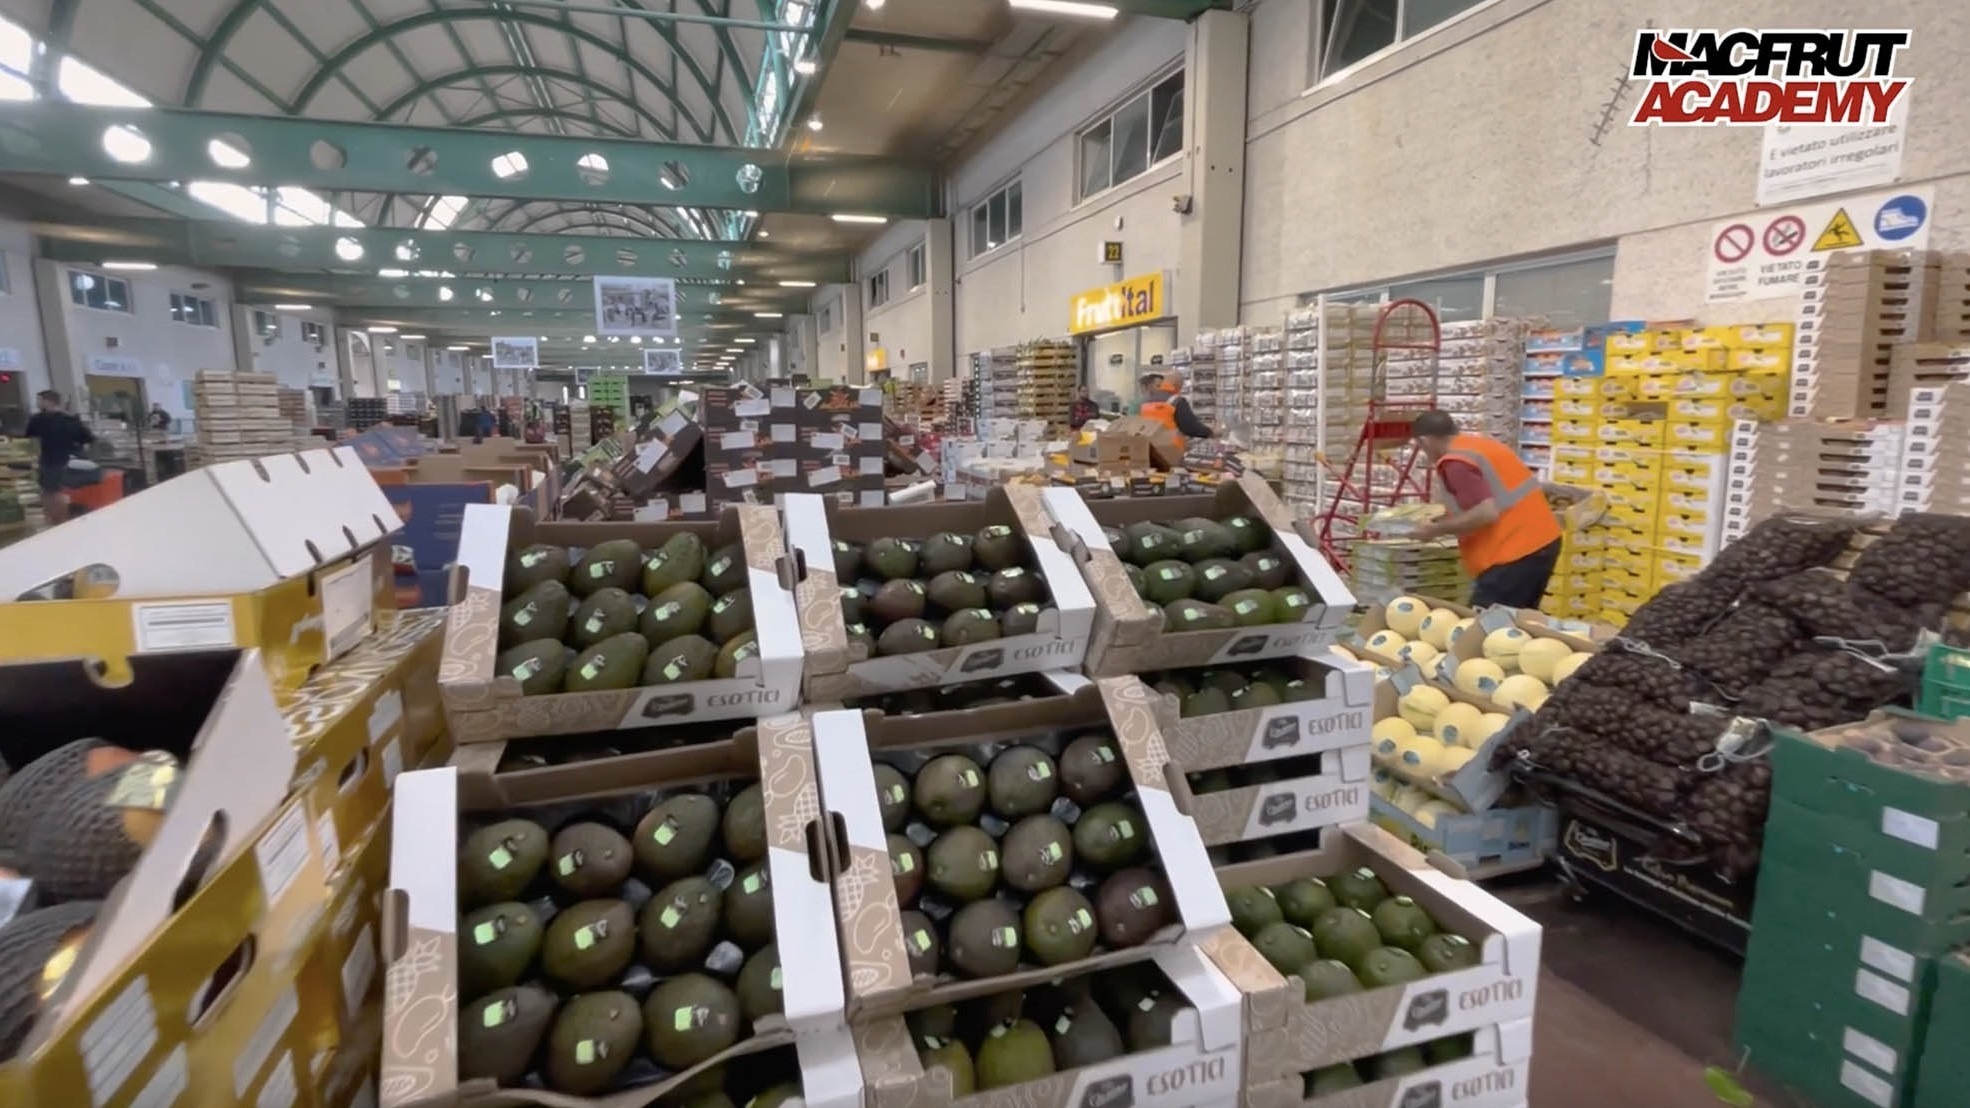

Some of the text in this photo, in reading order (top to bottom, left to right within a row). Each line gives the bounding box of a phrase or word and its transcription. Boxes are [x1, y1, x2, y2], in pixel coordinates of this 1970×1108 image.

[1780, 138, 1827, 158] vietato
[1829, 124, 1898, 146] utilizzare
[1764, 142, 1899, 179] lavoratori irregolari
[1760, 260, 1802, 273] VIETATO
[1758, 273, 1800, 286] FUMARE
[1014, 640, 1075, 661] ESOTICI
[707, 689, 780, 707] ESOTICI
[1308, 711, 1363, 736] ESOTICI
[1305, 787, 1359, 812] ESOTICI
[1459, 979, 1523, 1011] ESOTICI
[1146, 1055, 1225, 1096] ESOTICI
[1451, 1068, 1515, 1101] ESOTICI
